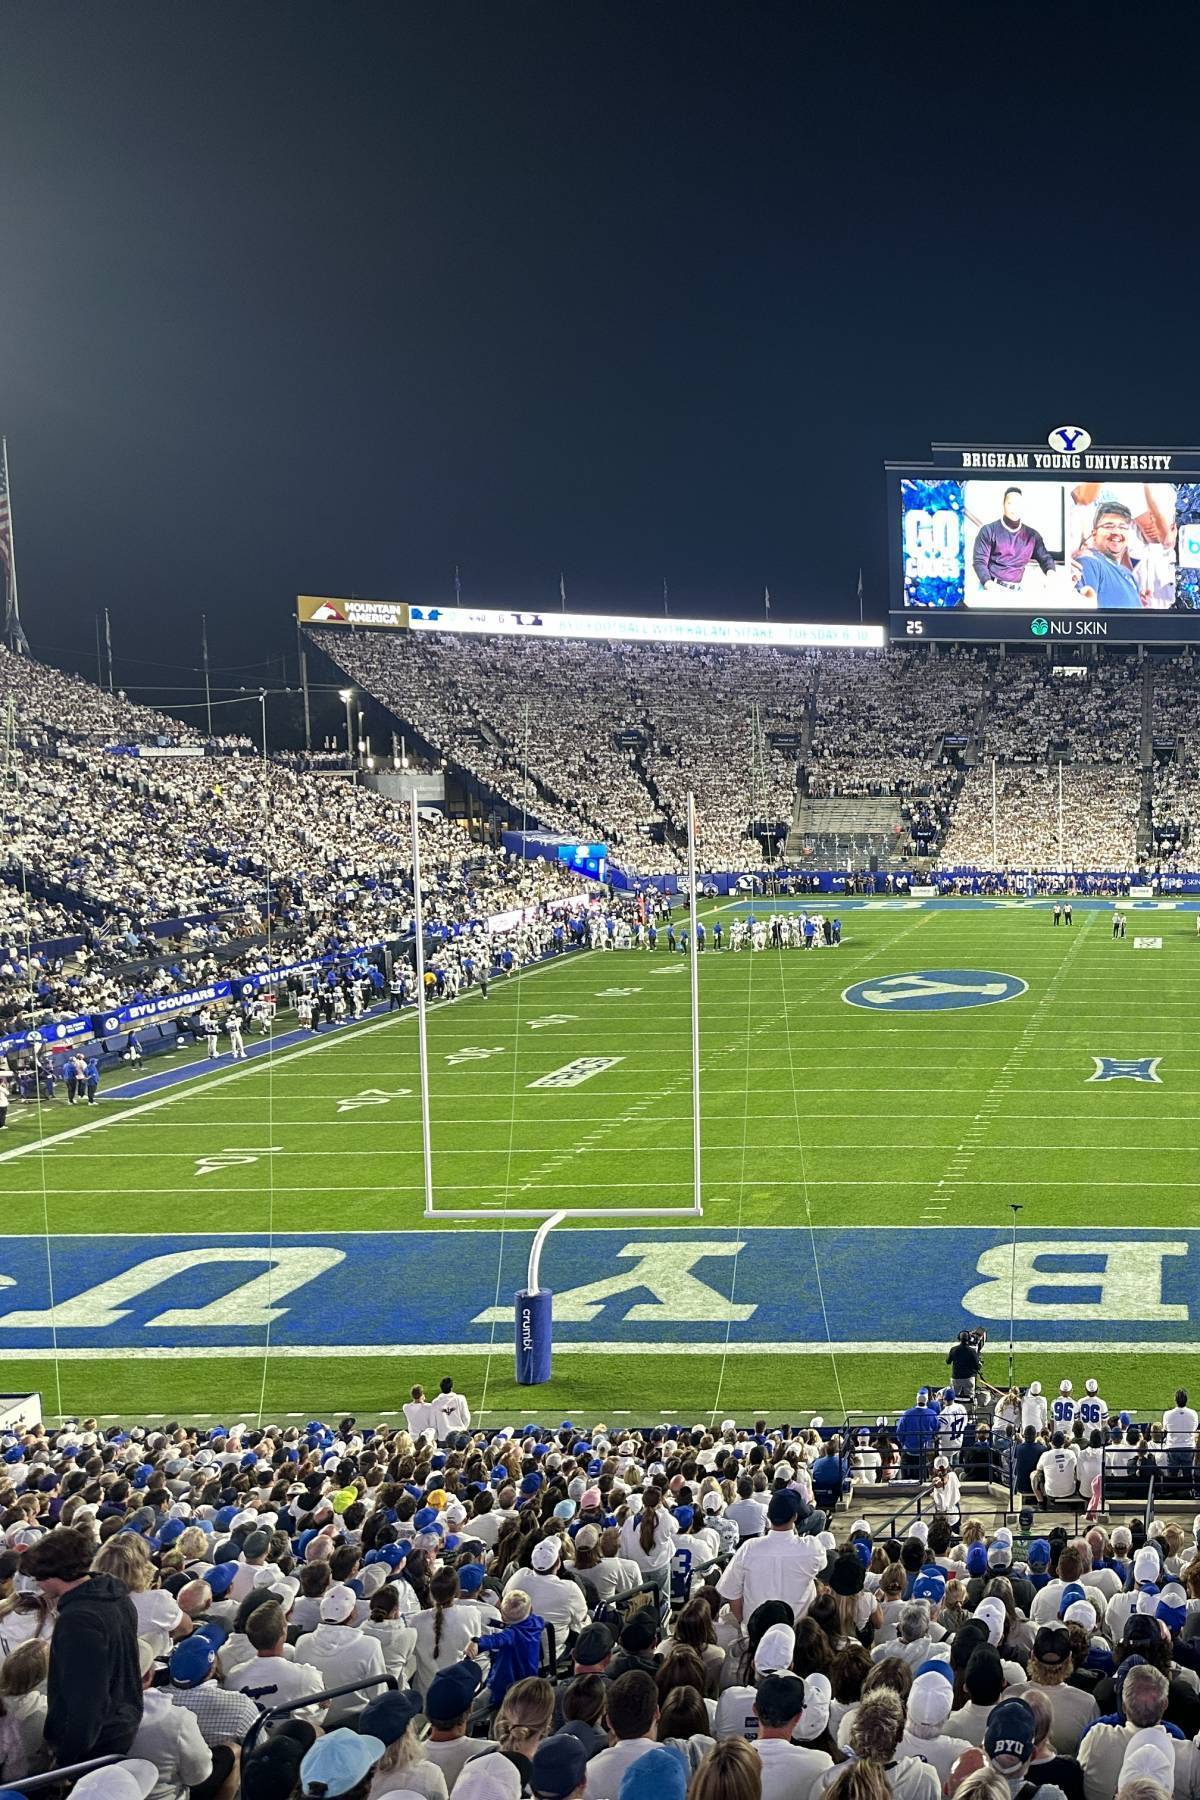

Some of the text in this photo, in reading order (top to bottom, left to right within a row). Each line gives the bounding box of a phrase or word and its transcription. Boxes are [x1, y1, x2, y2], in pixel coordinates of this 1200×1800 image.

[1055, 429, 1084, 451] Y
[962, 452, 1172, 470] BRIGHAM YOUNG UNIVERSITY
[905, 509, 960, 557] GO
[344, 601, 401, 615] MOUNTAIN
[347, 612, 399, 625] AMERICA
[906, 621, 923, 634] 25
[1050, 621, 1107, 635] NU SKIN
[259, 970, 279, 986] BYU
[129, 987, 216, 1019] BYU COUGARS
[450, 1046, 505, 1062] 30
[338, 1088, 412, 1106] 20
[196, 1146, 284, 1166] 10
[1054, 1401, 1074, 1422] 96
[1081, 1403, 1100, 1423] 96
[950, 1416, 966, 1441] 17
[675, 1548, 692, 1578] 3
[994, 1739, 1024, 1755] BYU
